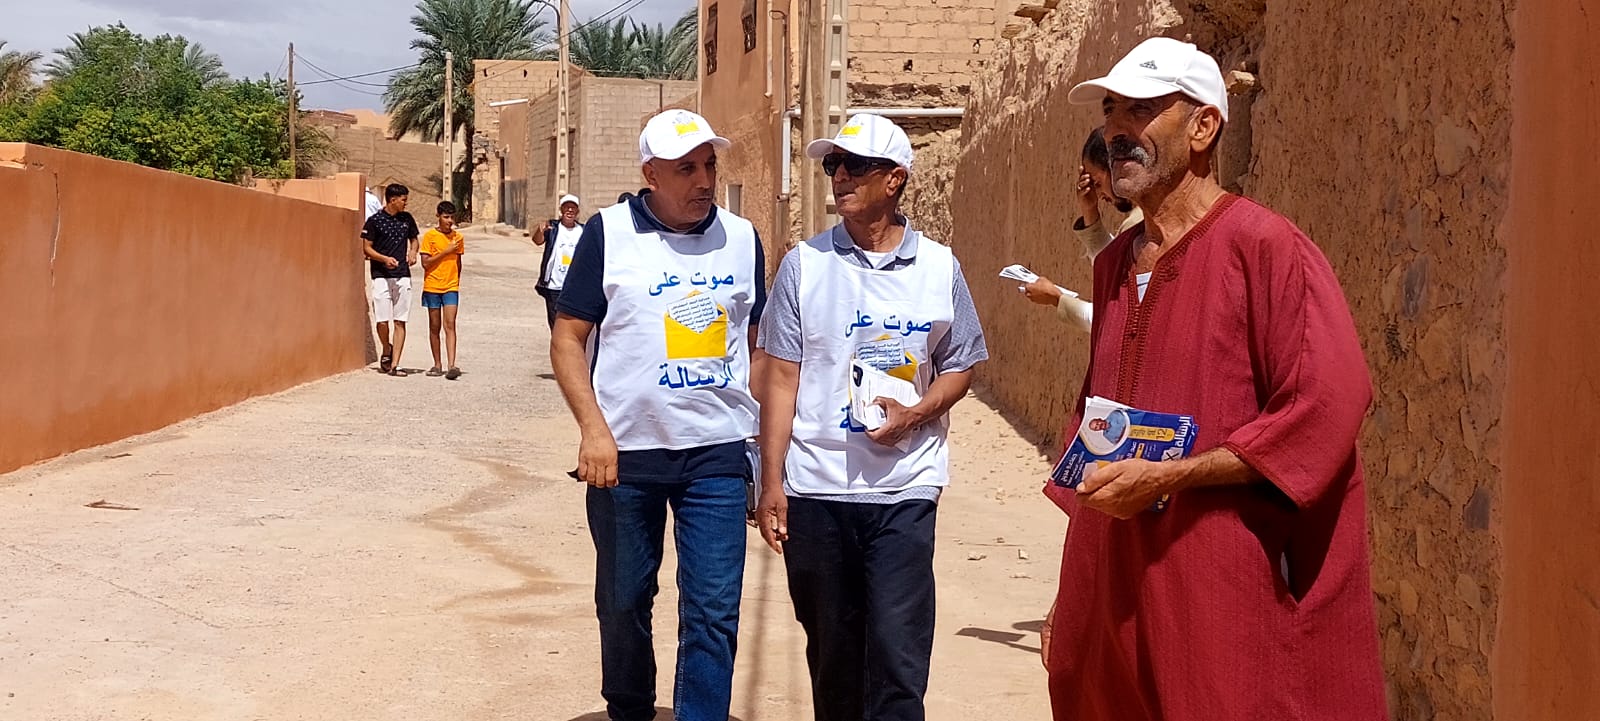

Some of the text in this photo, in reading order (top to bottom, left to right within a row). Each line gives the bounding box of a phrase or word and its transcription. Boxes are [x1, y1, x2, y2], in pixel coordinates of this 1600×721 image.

[648, 272, 734, 296] صوت على
[845, 309, 932, 337] صوت على
[658, 363, 736, 389] الرسالة
[1155, 428, 1168, 439] 12
[1174, 416, 1191, 447] الرسالة
